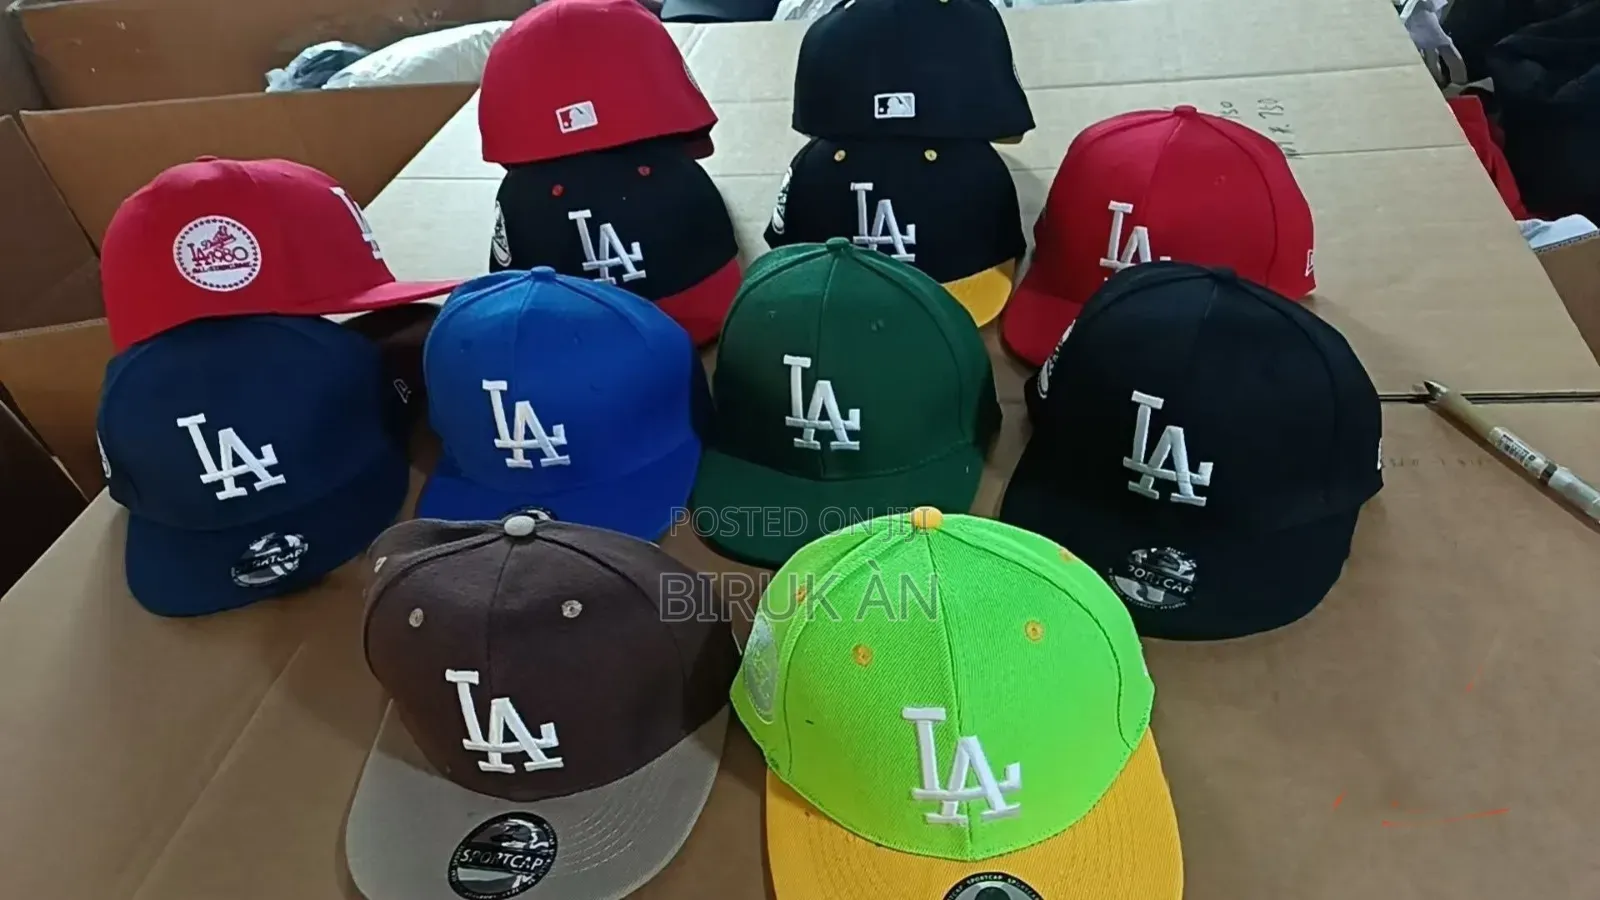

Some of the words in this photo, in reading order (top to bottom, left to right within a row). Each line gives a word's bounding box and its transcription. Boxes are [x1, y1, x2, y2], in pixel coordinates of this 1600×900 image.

[568, 209, 646, 284] LA
[850, 182, 916, 262] LA
[482, 379, 571, 468] LA
[784, 354, 861, 451] LA
[177, 412, 286, 501] LA
[1123, 390, 1214, 507] LA
[445, 668, 564, 774] LA
[902, 706, 1022, 825] LA
[460, 849, 544, 871] SPORTCAP
